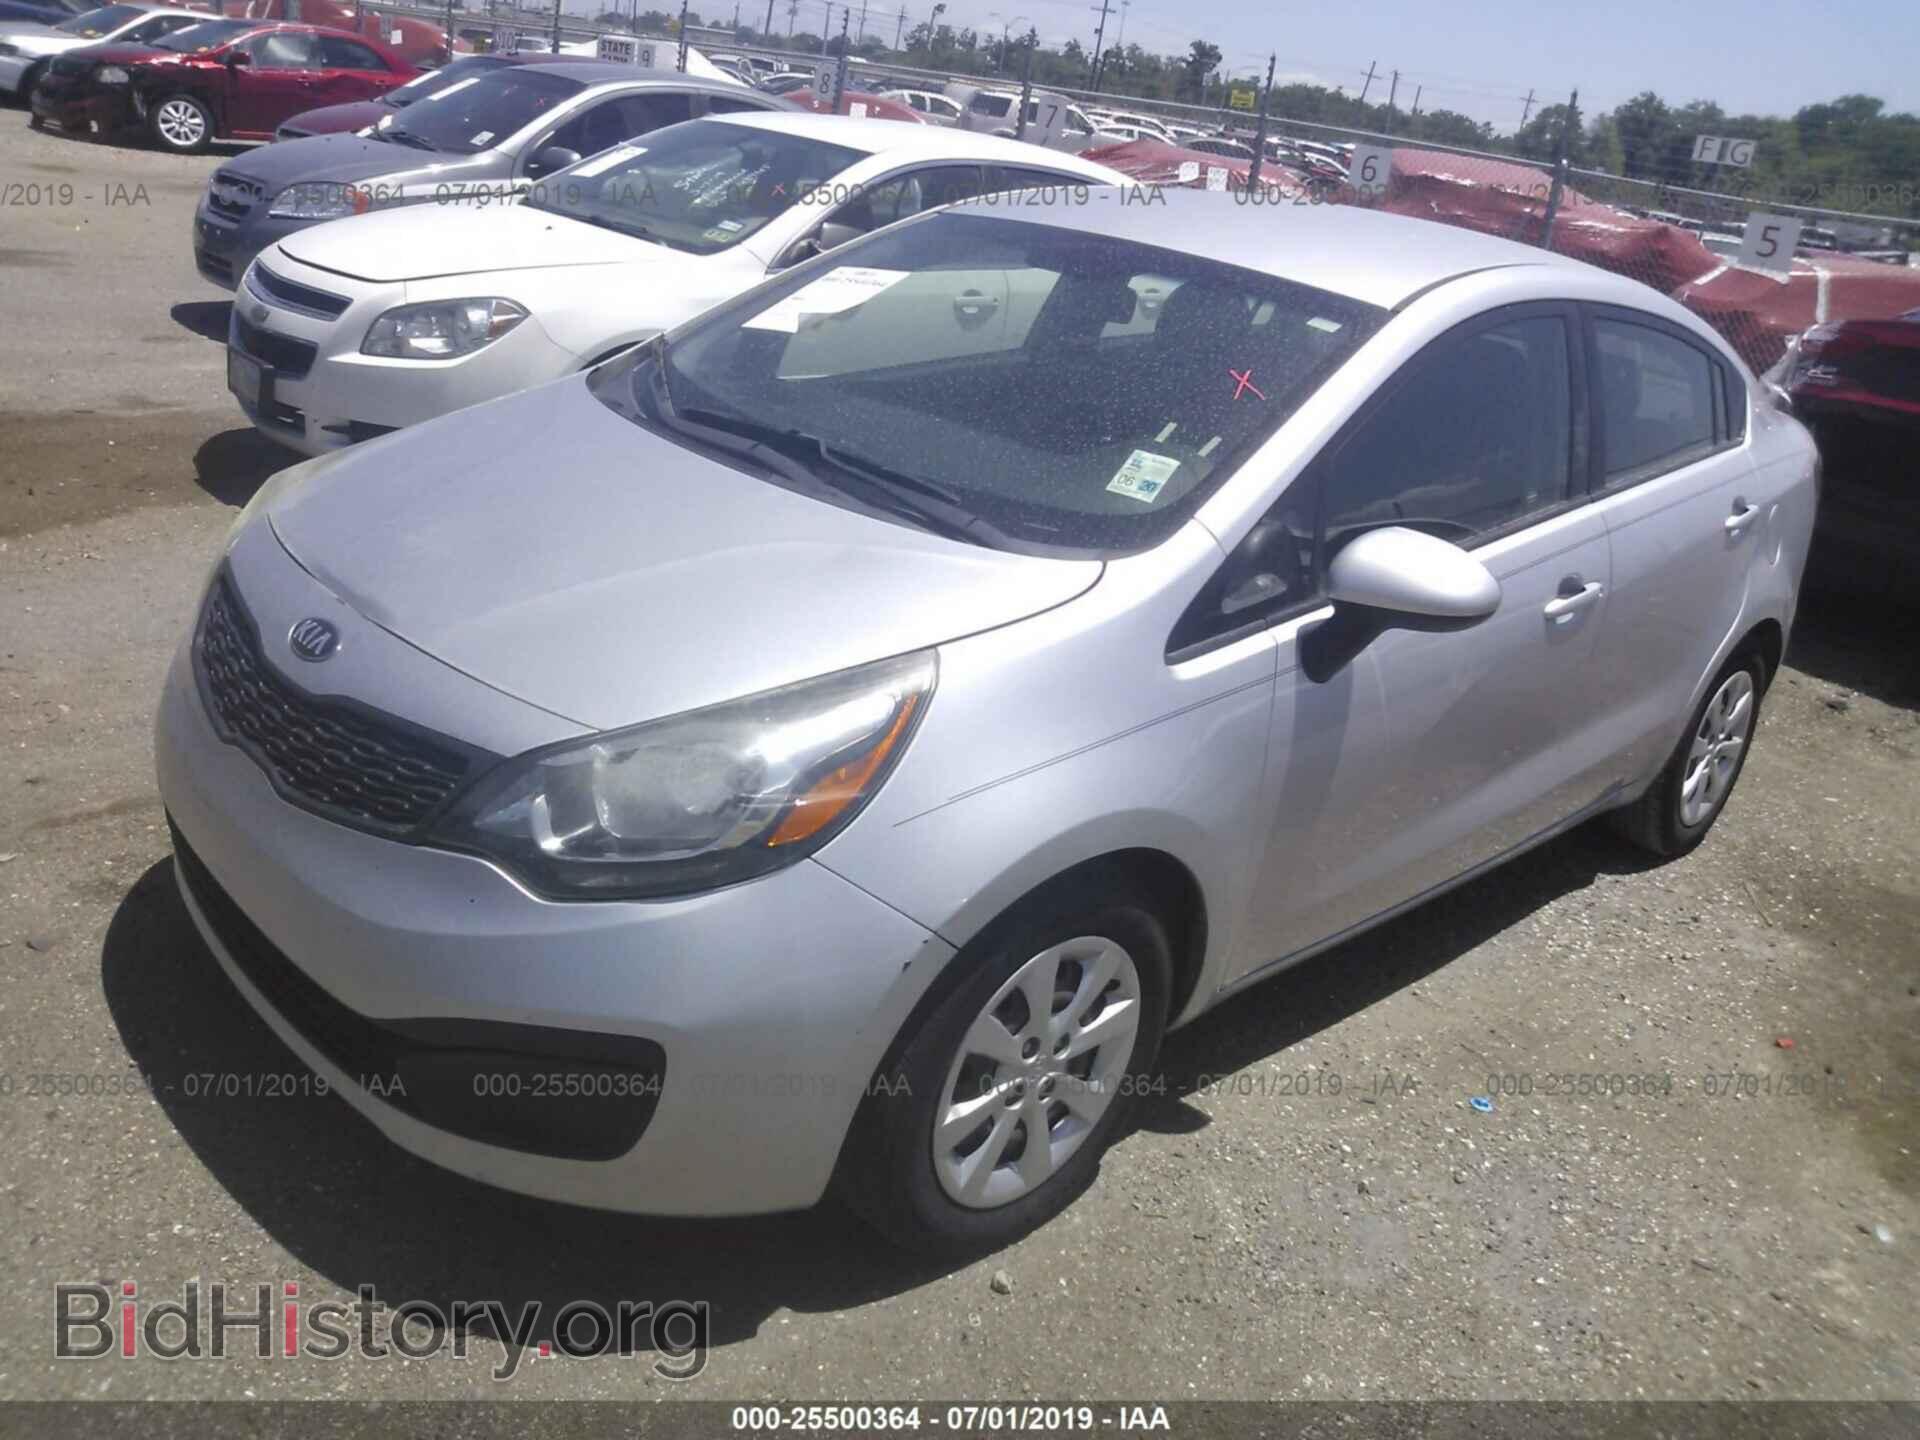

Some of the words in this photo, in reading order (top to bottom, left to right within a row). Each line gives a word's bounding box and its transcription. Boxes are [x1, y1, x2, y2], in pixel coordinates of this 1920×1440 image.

[601, 39, 631, 55] STATE
[642, 50, 650, 68] 9
[819, 73, 831, 94] 8
[1045, 104, 1059, 129] 7
[1698, 137, 1753, 165] FIG
[1360, 154, 1380, 182] 6
[1755, 224, 1781, 257] 5
